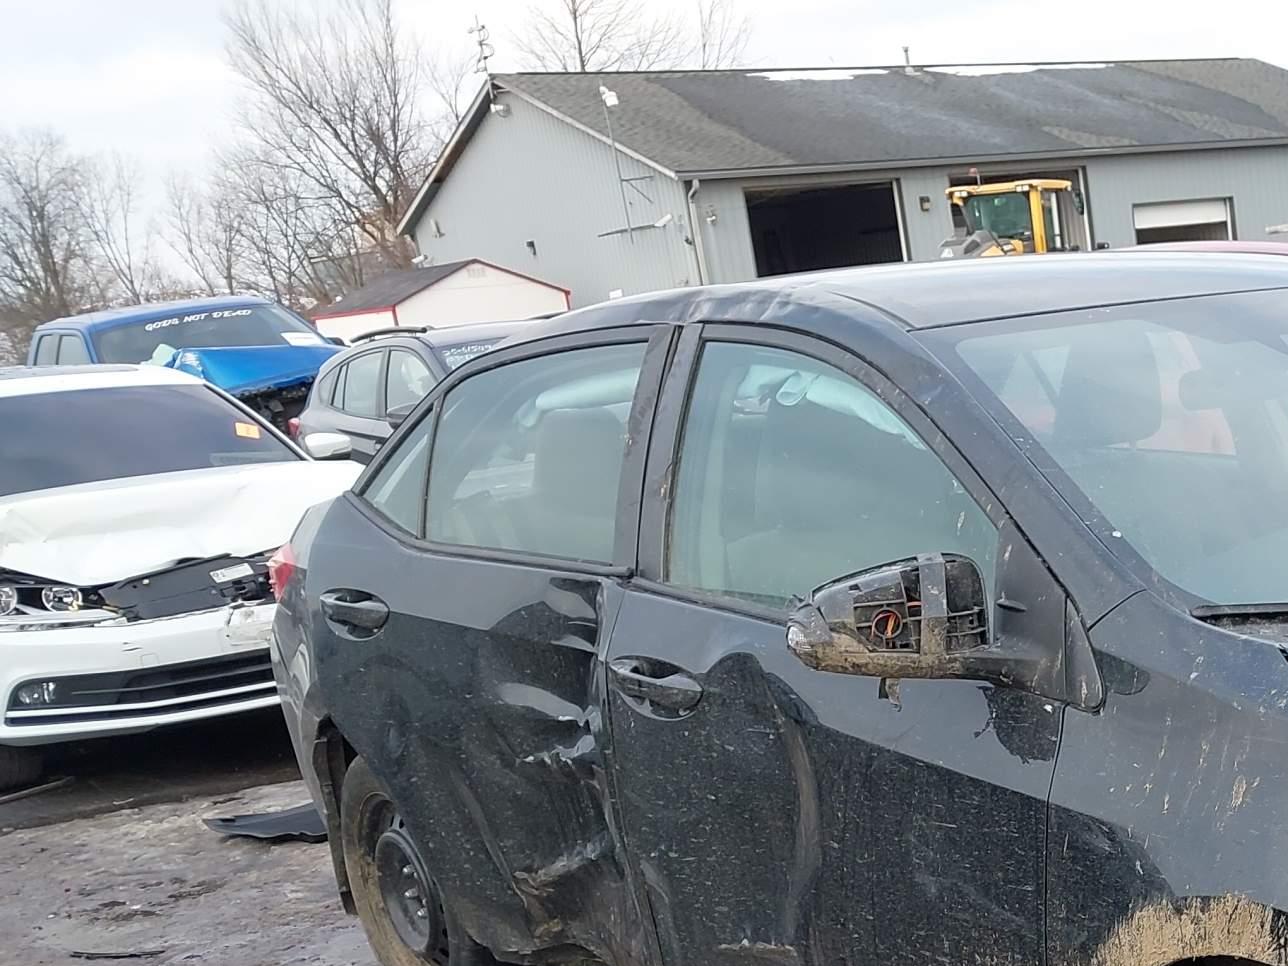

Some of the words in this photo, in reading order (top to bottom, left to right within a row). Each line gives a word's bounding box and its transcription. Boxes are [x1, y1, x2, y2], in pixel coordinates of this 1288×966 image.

[145, 318, 180, 331] GODS
[183, 312, 209, 323] NOT
[211, 309, 252, 319] DEAD
